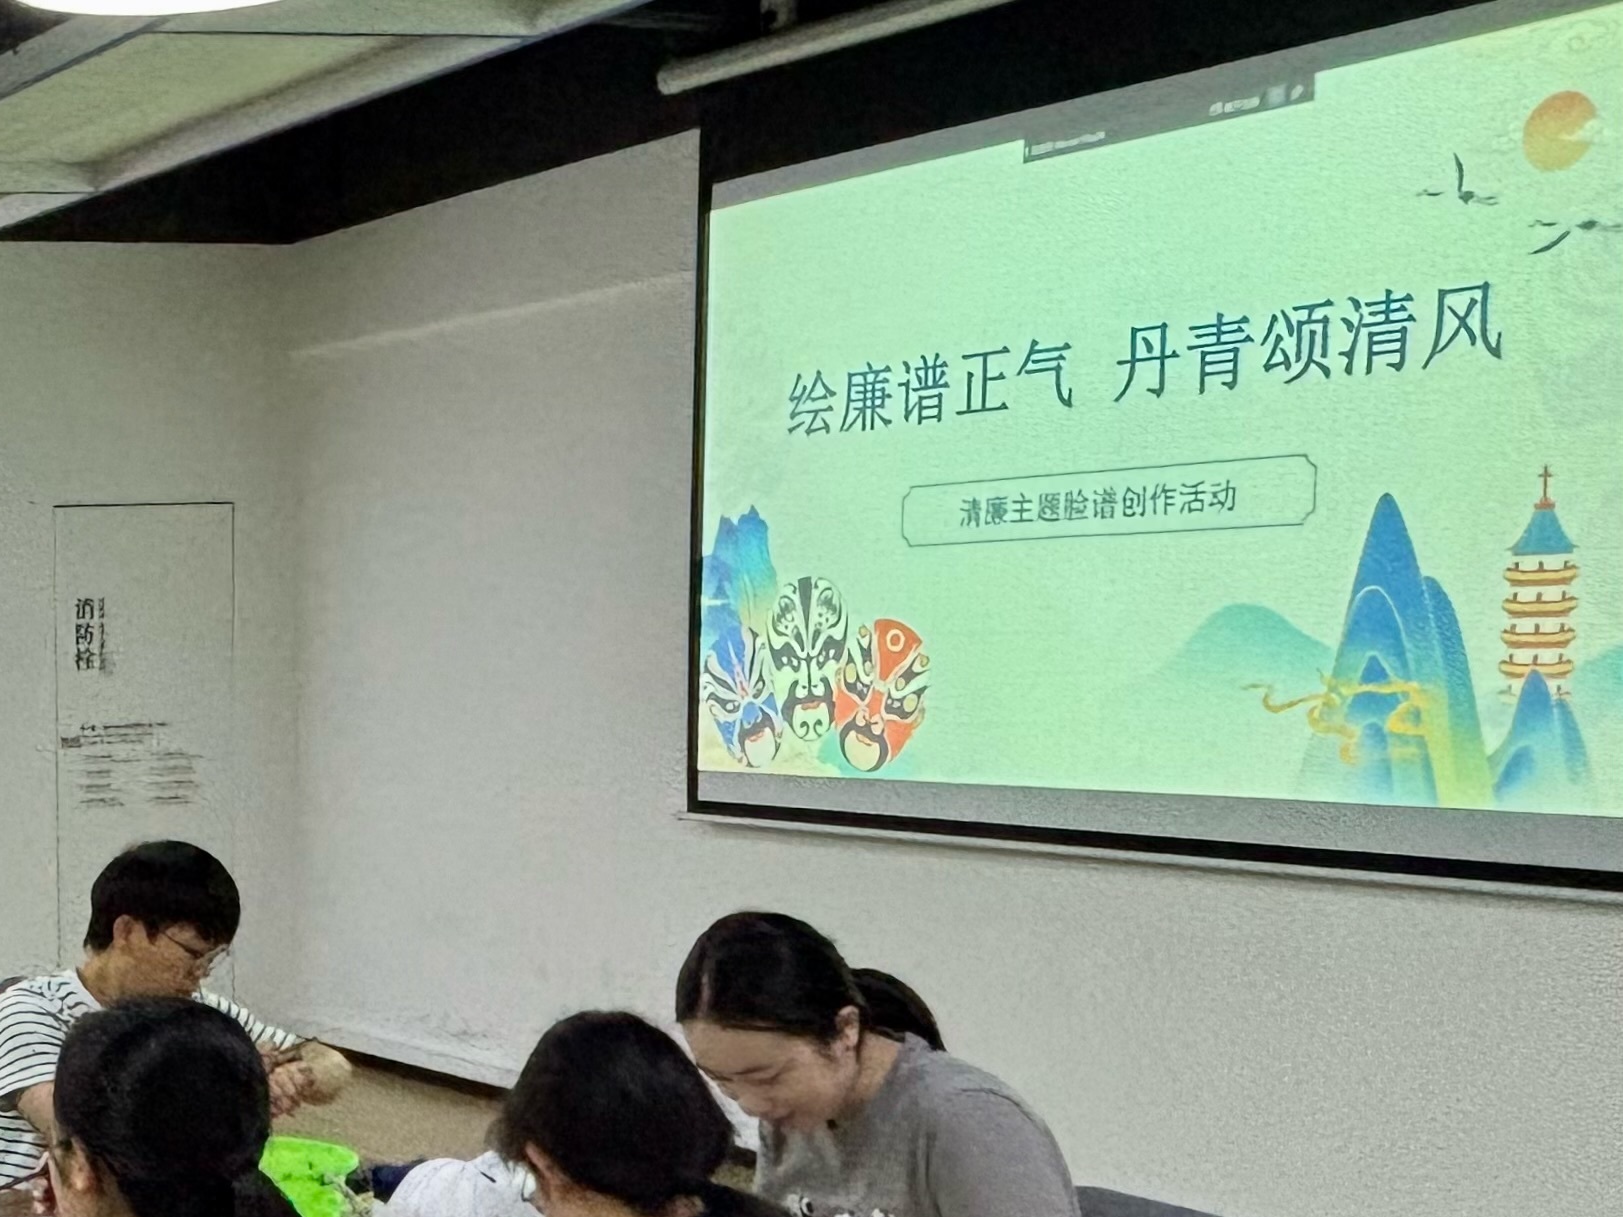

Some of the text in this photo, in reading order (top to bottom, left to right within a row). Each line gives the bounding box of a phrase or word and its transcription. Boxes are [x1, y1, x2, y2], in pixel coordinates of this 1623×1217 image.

[787, 281, 1503, 436] 绘廉谱正气 丹青颂清风
[960, 479, 1236, 528] 清廉主题脸谱创作活动
